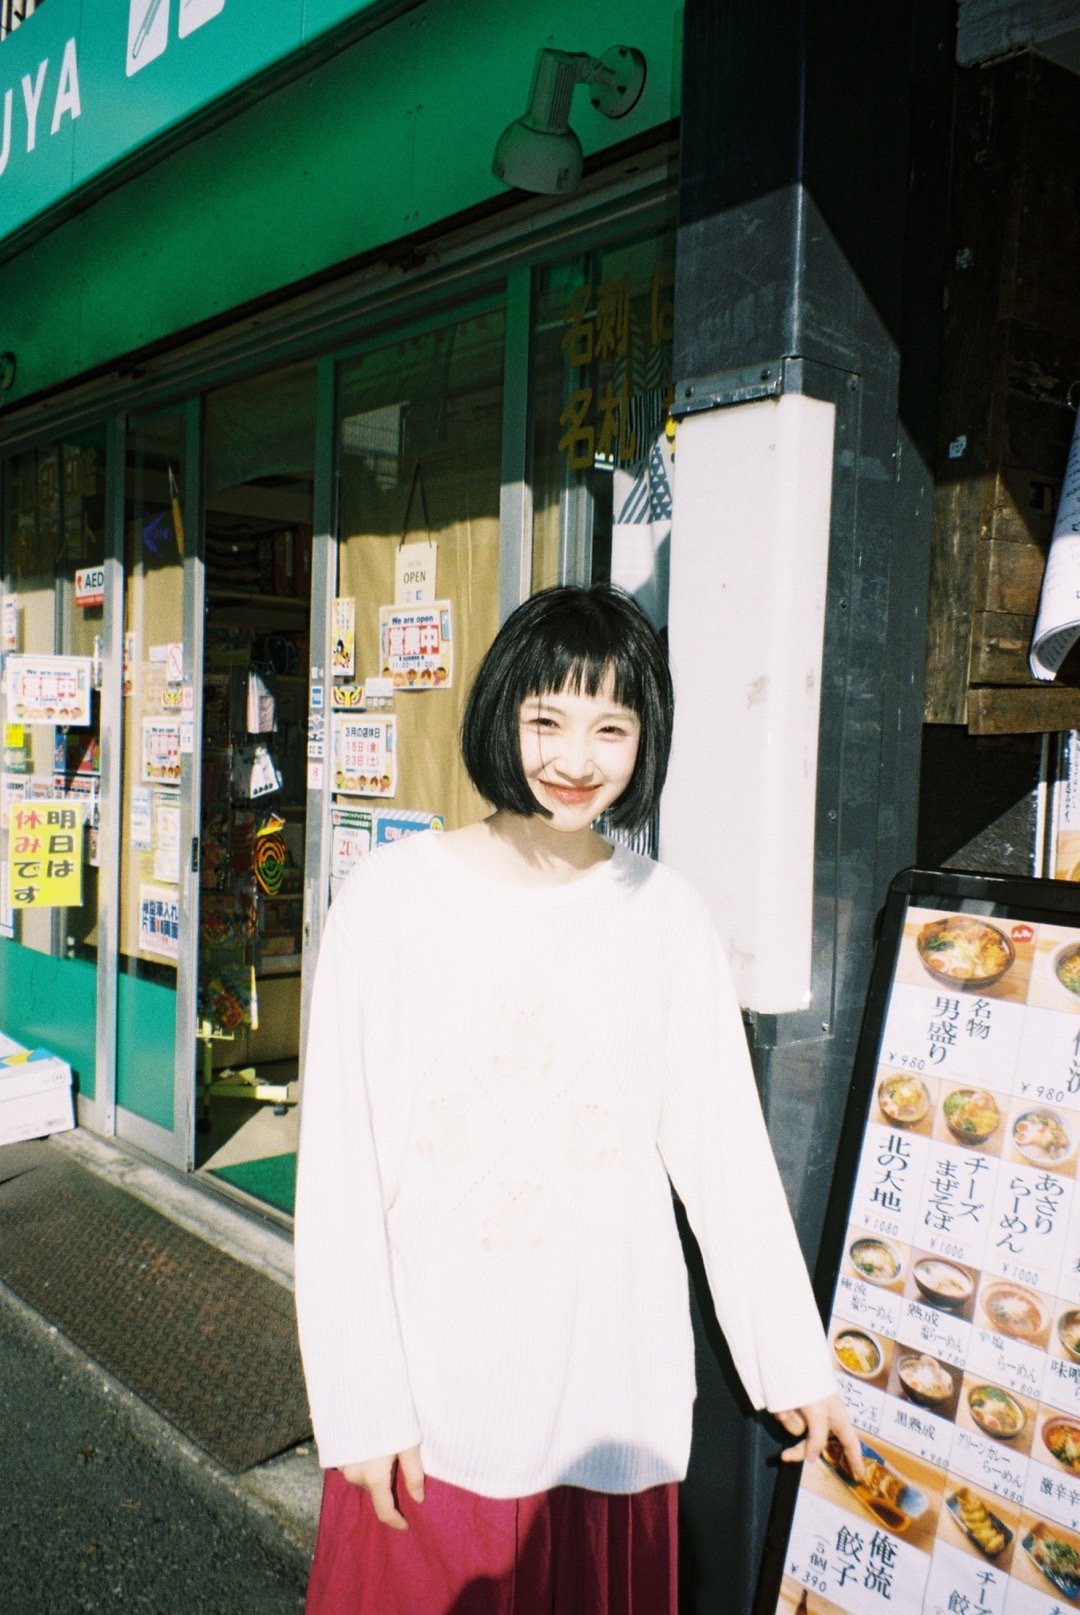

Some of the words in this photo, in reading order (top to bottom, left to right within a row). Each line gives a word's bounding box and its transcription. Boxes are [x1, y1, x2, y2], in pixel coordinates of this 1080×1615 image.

[84, 570, 104, 589] AED
[403, 570, 427, 584] OPEN
[391, 616, 402, 625] We
[403, 616, 415, 624] are
[416, 614, 434, 624] open
[345, 726, 381, 739] 3月の店休日
[14, 810, 42, 904] 休みです
[47, 809, 76, 878] 明日は
[927, 996, 960, 1065] 男盛り
[966, 998, 993, 1040] 名物
[888, 1051, 925, 1071] ¥980
[1021, 1081, 1064, 1103] ¥980
[870, 1134, 911, 1213] 北の大地
[961, 1157, 989, 1222] チーズ
[924, 1160, 959, 1232] まぜそば
[996, 1177, 1031, 1254] らーめん
[1035, 1174, 1064, 1235] あさり
[907, 1303, 939, 1327] 熟成
[895, 1411, 937, 1441] 黒熟成
[983, 1460, 1022, 1488] らーめん
[790, 1562, 827, 1592] ¥390
[832, 1525, 864, 1587] 餃子
[863, 1529, 898, 1600] 俺流
